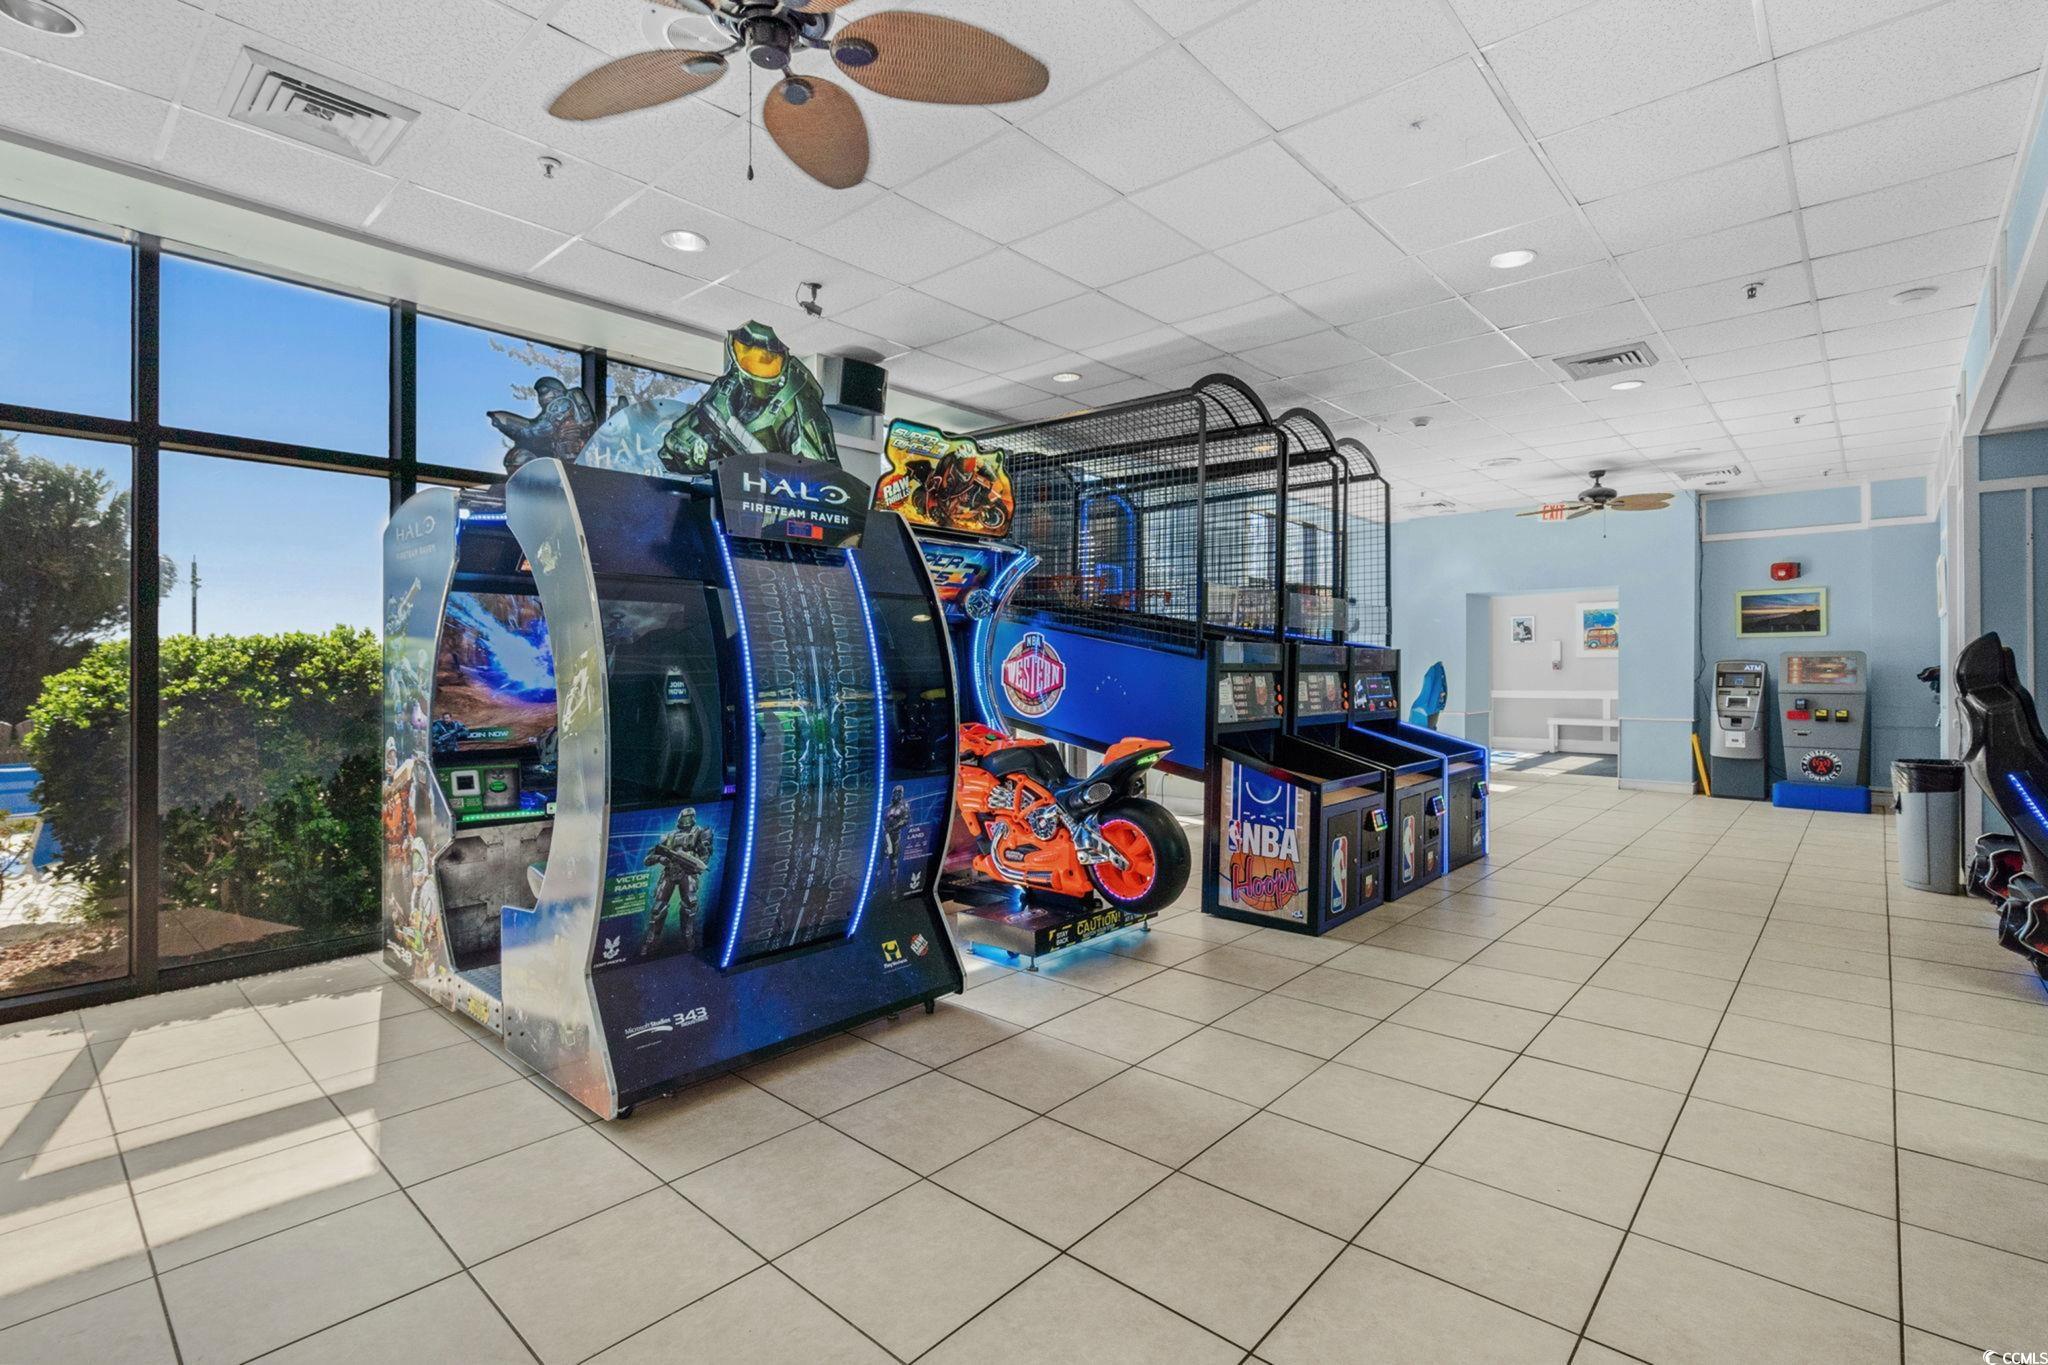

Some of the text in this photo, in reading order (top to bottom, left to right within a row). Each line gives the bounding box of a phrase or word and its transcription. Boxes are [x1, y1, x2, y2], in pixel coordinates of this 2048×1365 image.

[894, 428, 940, 443] SUPER
[743, 472, 851, 504] HALO
[883, 476, 911, 501] RAW
[742, 501, 849, 525] FIRETEAM RAVEN
[1542, 504, 1566, 520] EXIT
[395, 515, 436, 541] HALO
[1007, 655, 1060, 694] WESTERN
[907, 832, 925, 840] LAND
[1242, 821, 1300, 863] NBA
[614, 881, 649, 892] RAMOS
[616, 873, 650, 883] VICTOR
[1232, 855, 1299, 909] Hoops
[673, 1006, 708, 1026] 343
[624, 1021, 650, 1035] Microsoft
